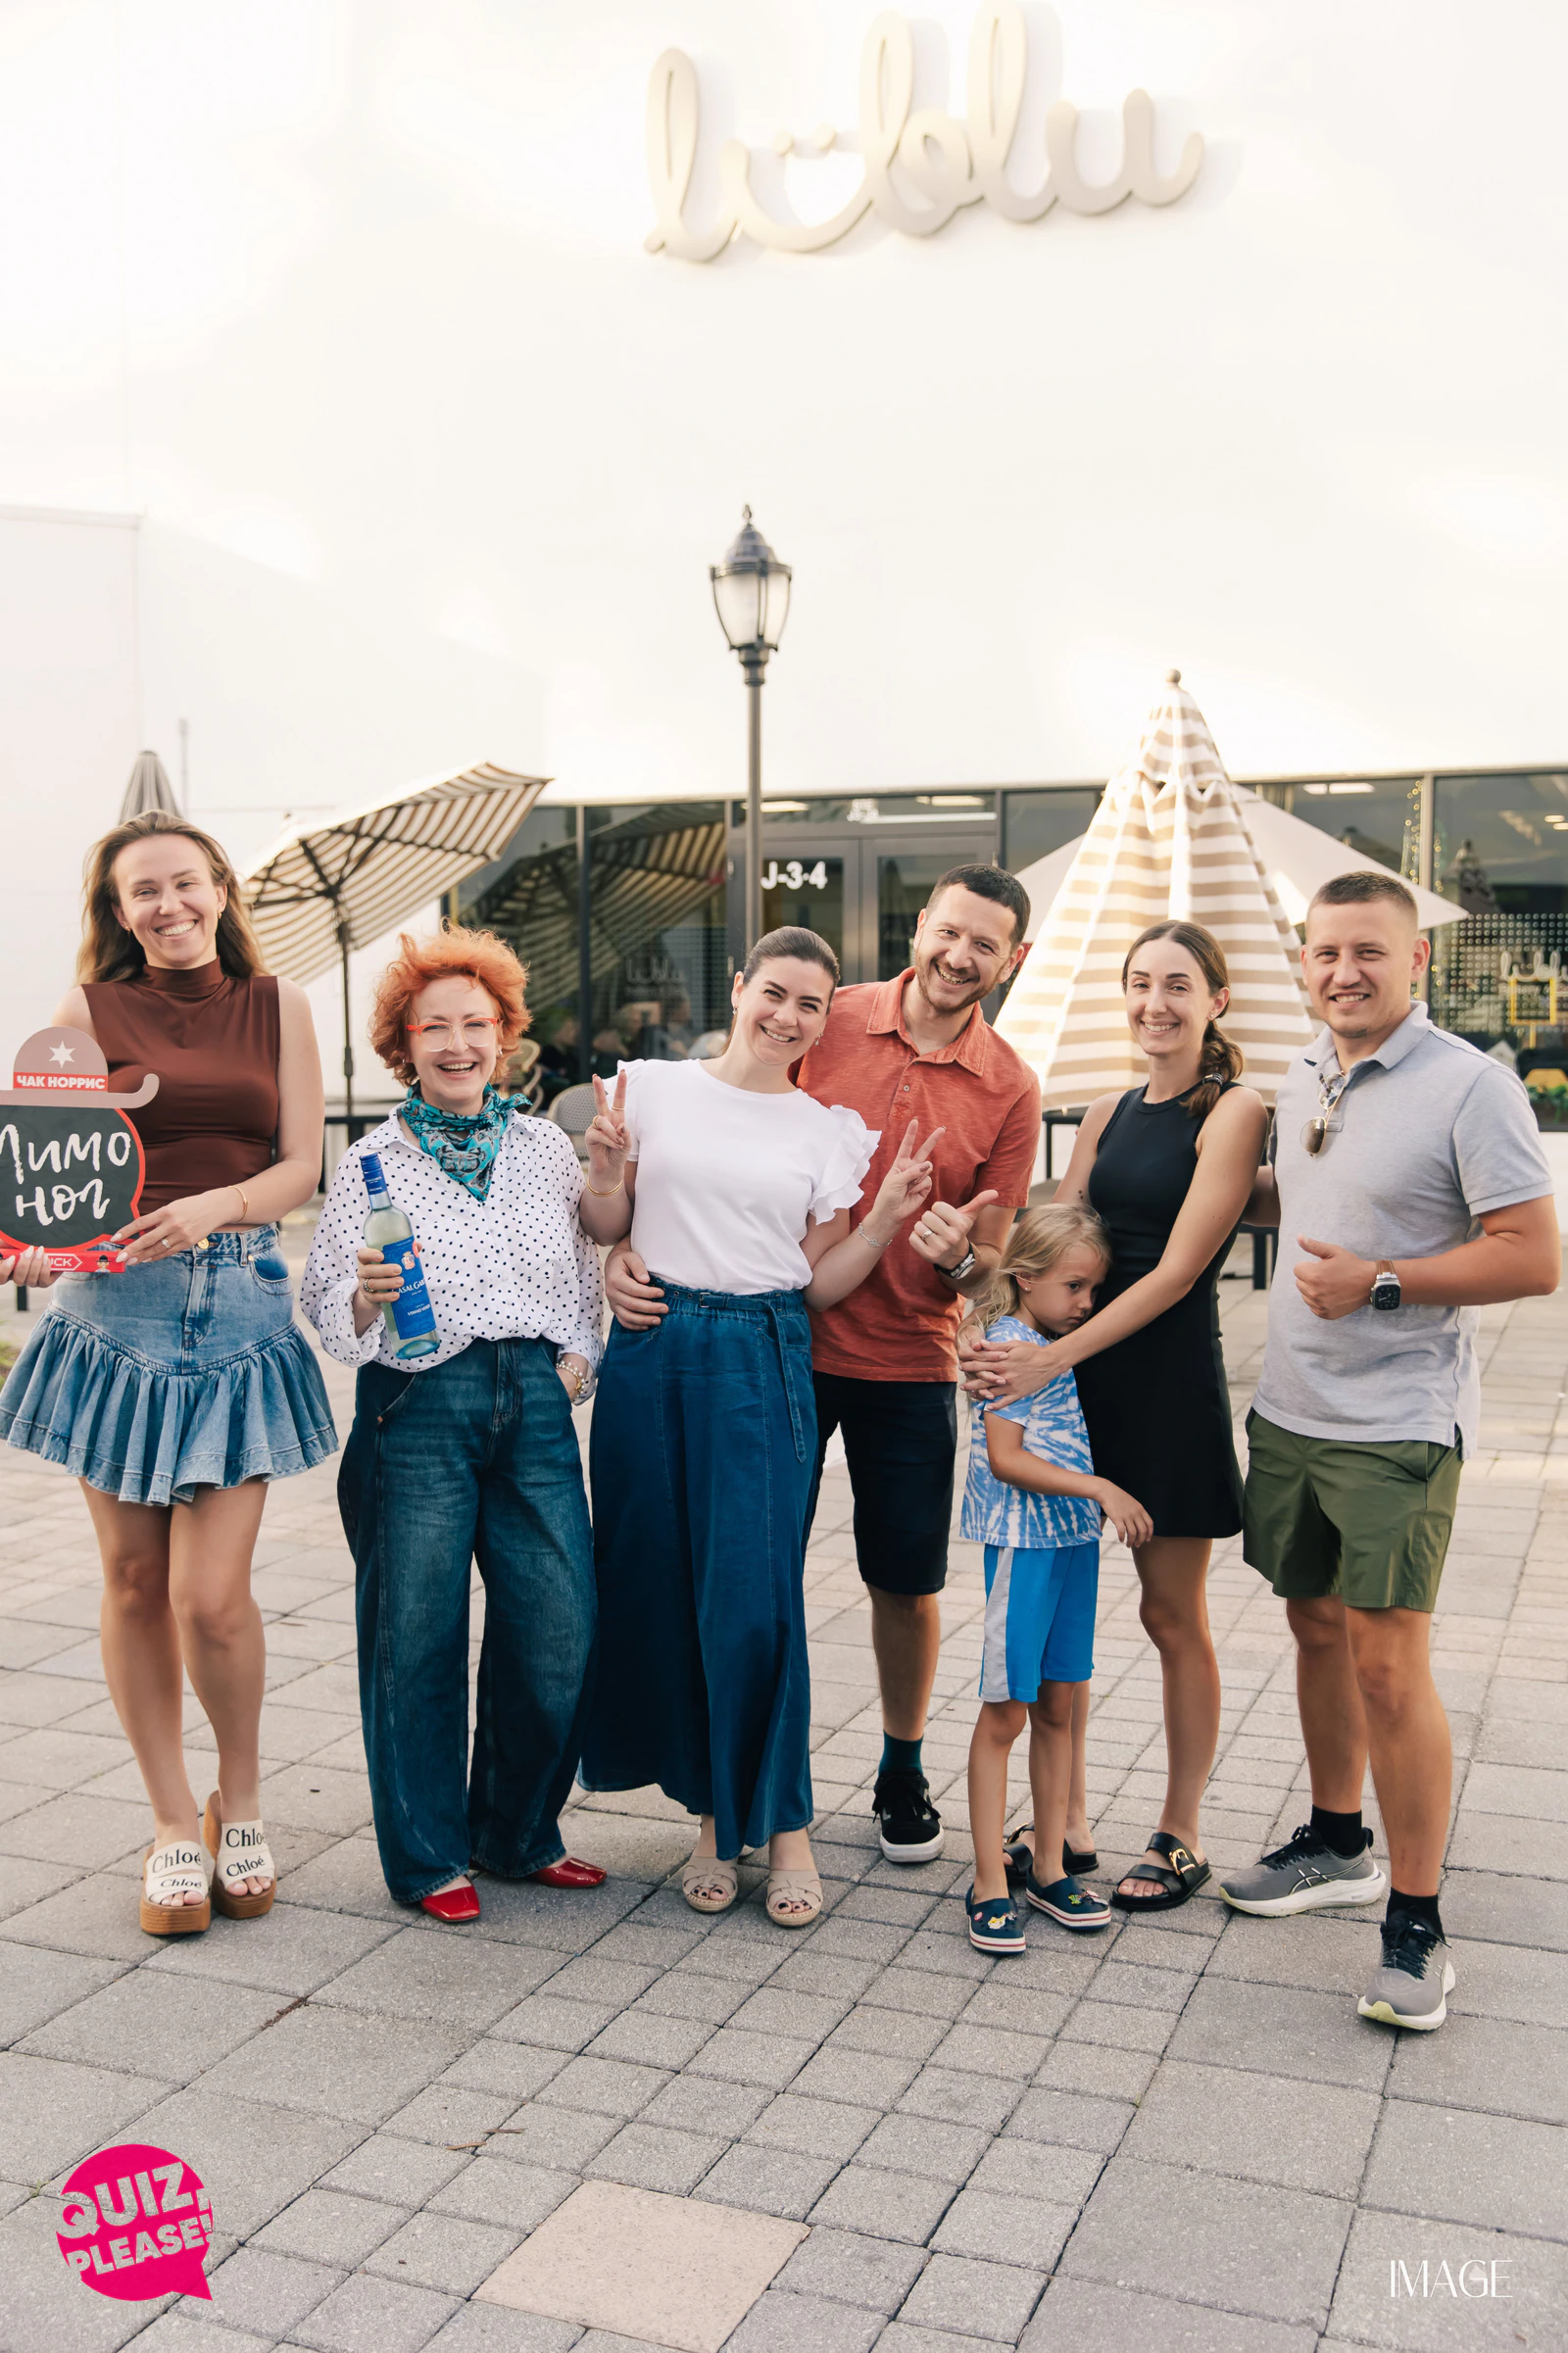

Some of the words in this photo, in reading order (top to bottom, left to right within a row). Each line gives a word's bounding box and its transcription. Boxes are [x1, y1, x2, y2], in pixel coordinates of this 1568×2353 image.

[17, 1075, 46, 1088] ЧАК
[48, 1076, 106, 1090] НОРРИС
[392, 1285, 414, 1294] ASAL
[226, 1855, 266, 1877] Chloé
